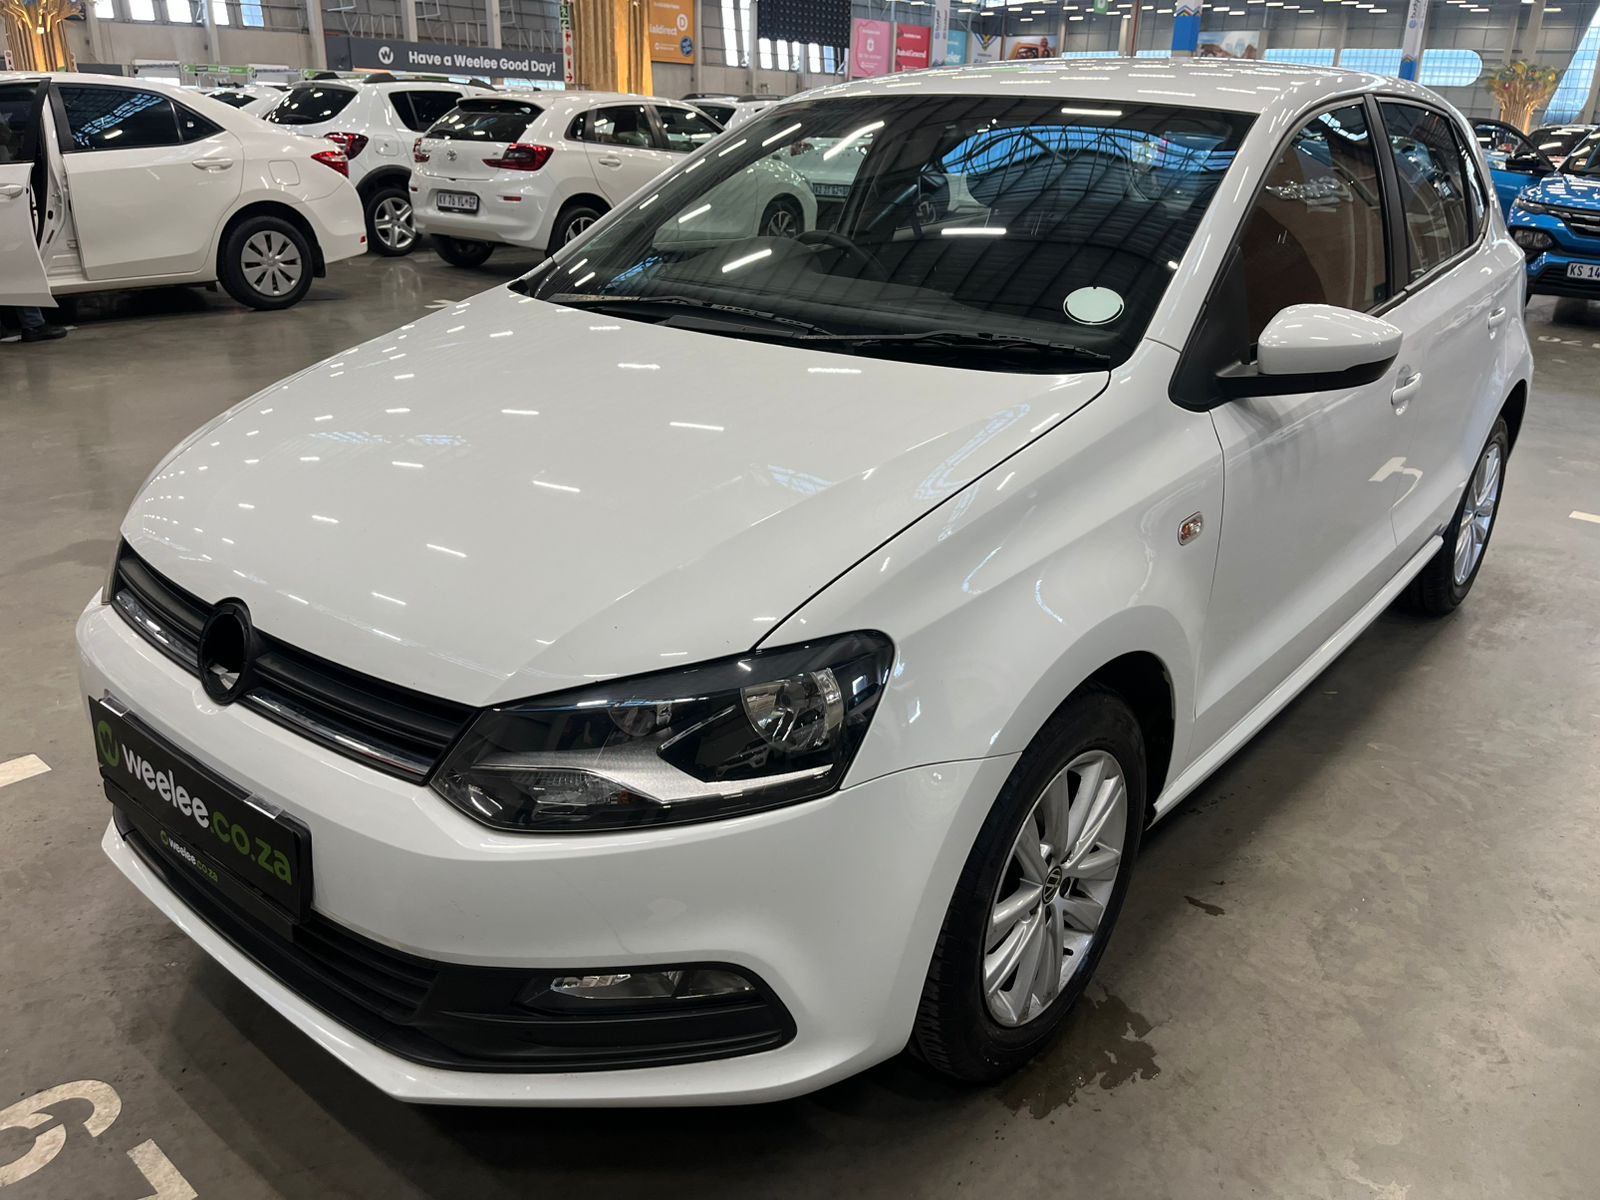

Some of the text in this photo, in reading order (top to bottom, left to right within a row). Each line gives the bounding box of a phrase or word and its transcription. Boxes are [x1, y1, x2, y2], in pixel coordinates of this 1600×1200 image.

[408, 51, 556, 76] Have a Weelee Good Day!
[1569, 264, 1584, 277] KS
[121, 743, 293, 886] weelee.co.za
